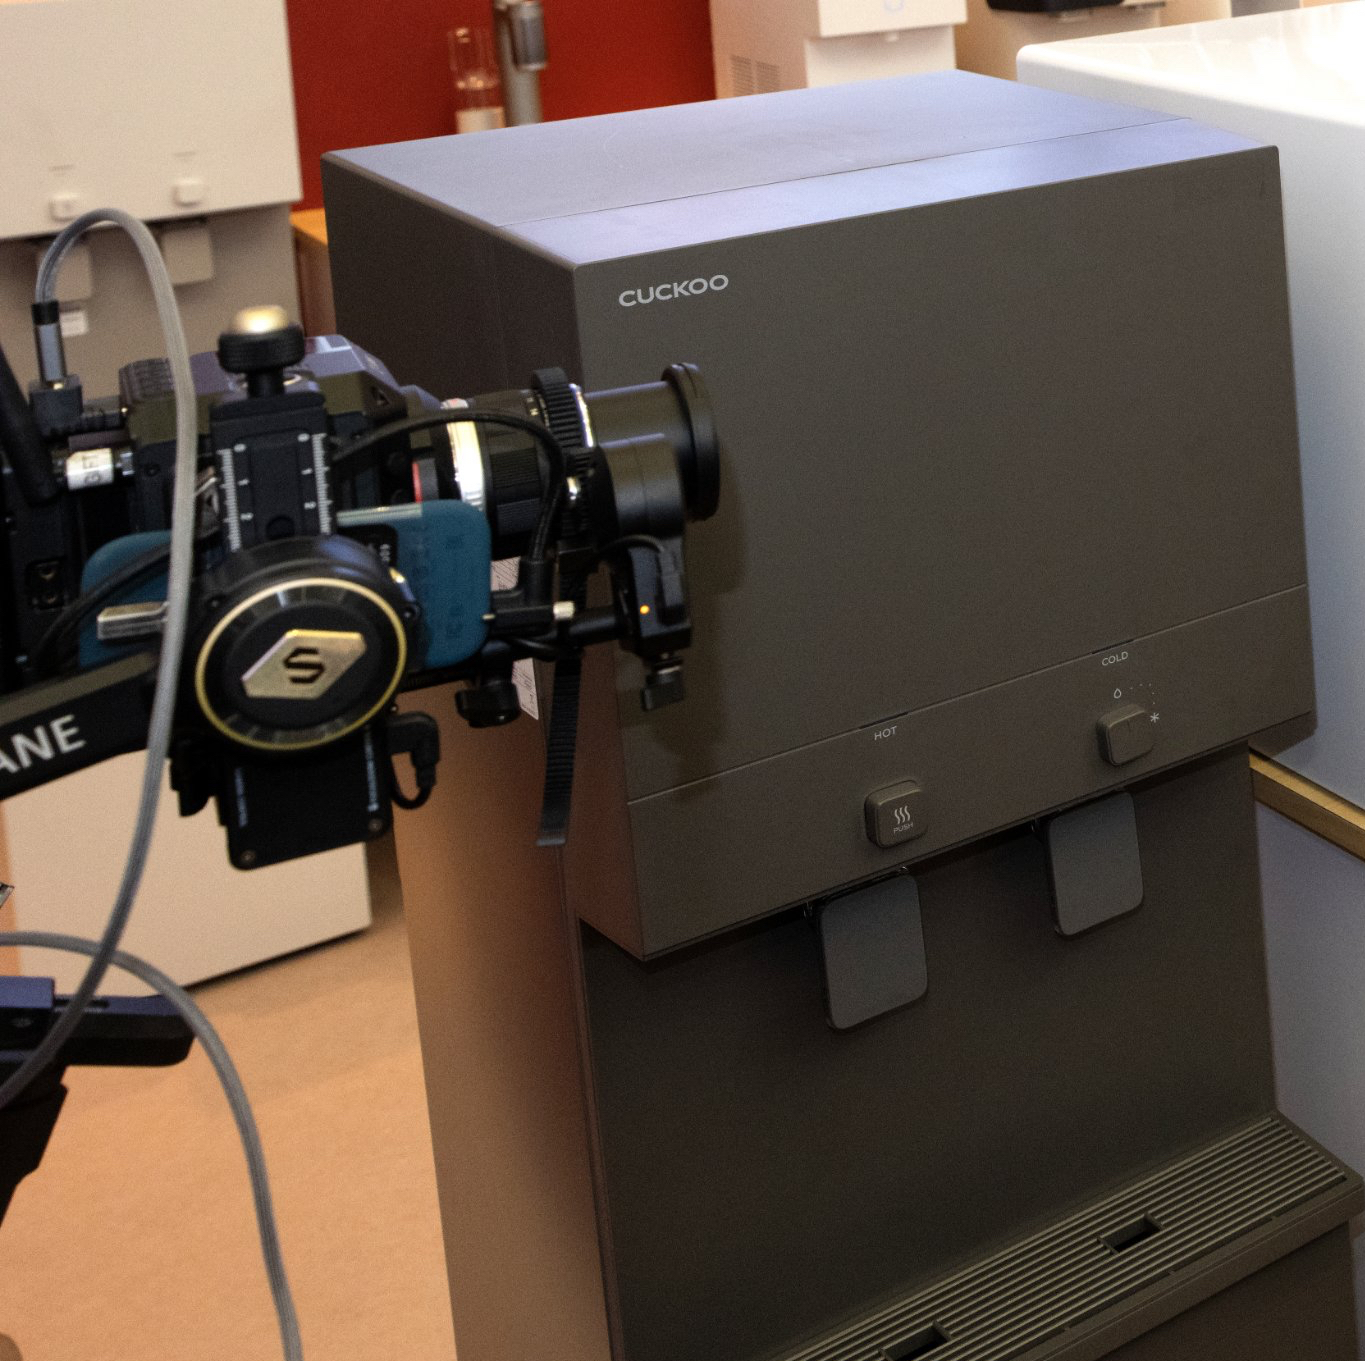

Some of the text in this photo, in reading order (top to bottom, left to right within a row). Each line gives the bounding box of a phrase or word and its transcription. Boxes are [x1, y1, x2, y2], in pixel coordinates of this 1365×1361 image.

[618, 274, 729, 307] CUCKOO
[1101, 651, 1128, 667] COLD
[873, 725, 898, 741] HOT
[893, 821, 914, 835] PUSH
